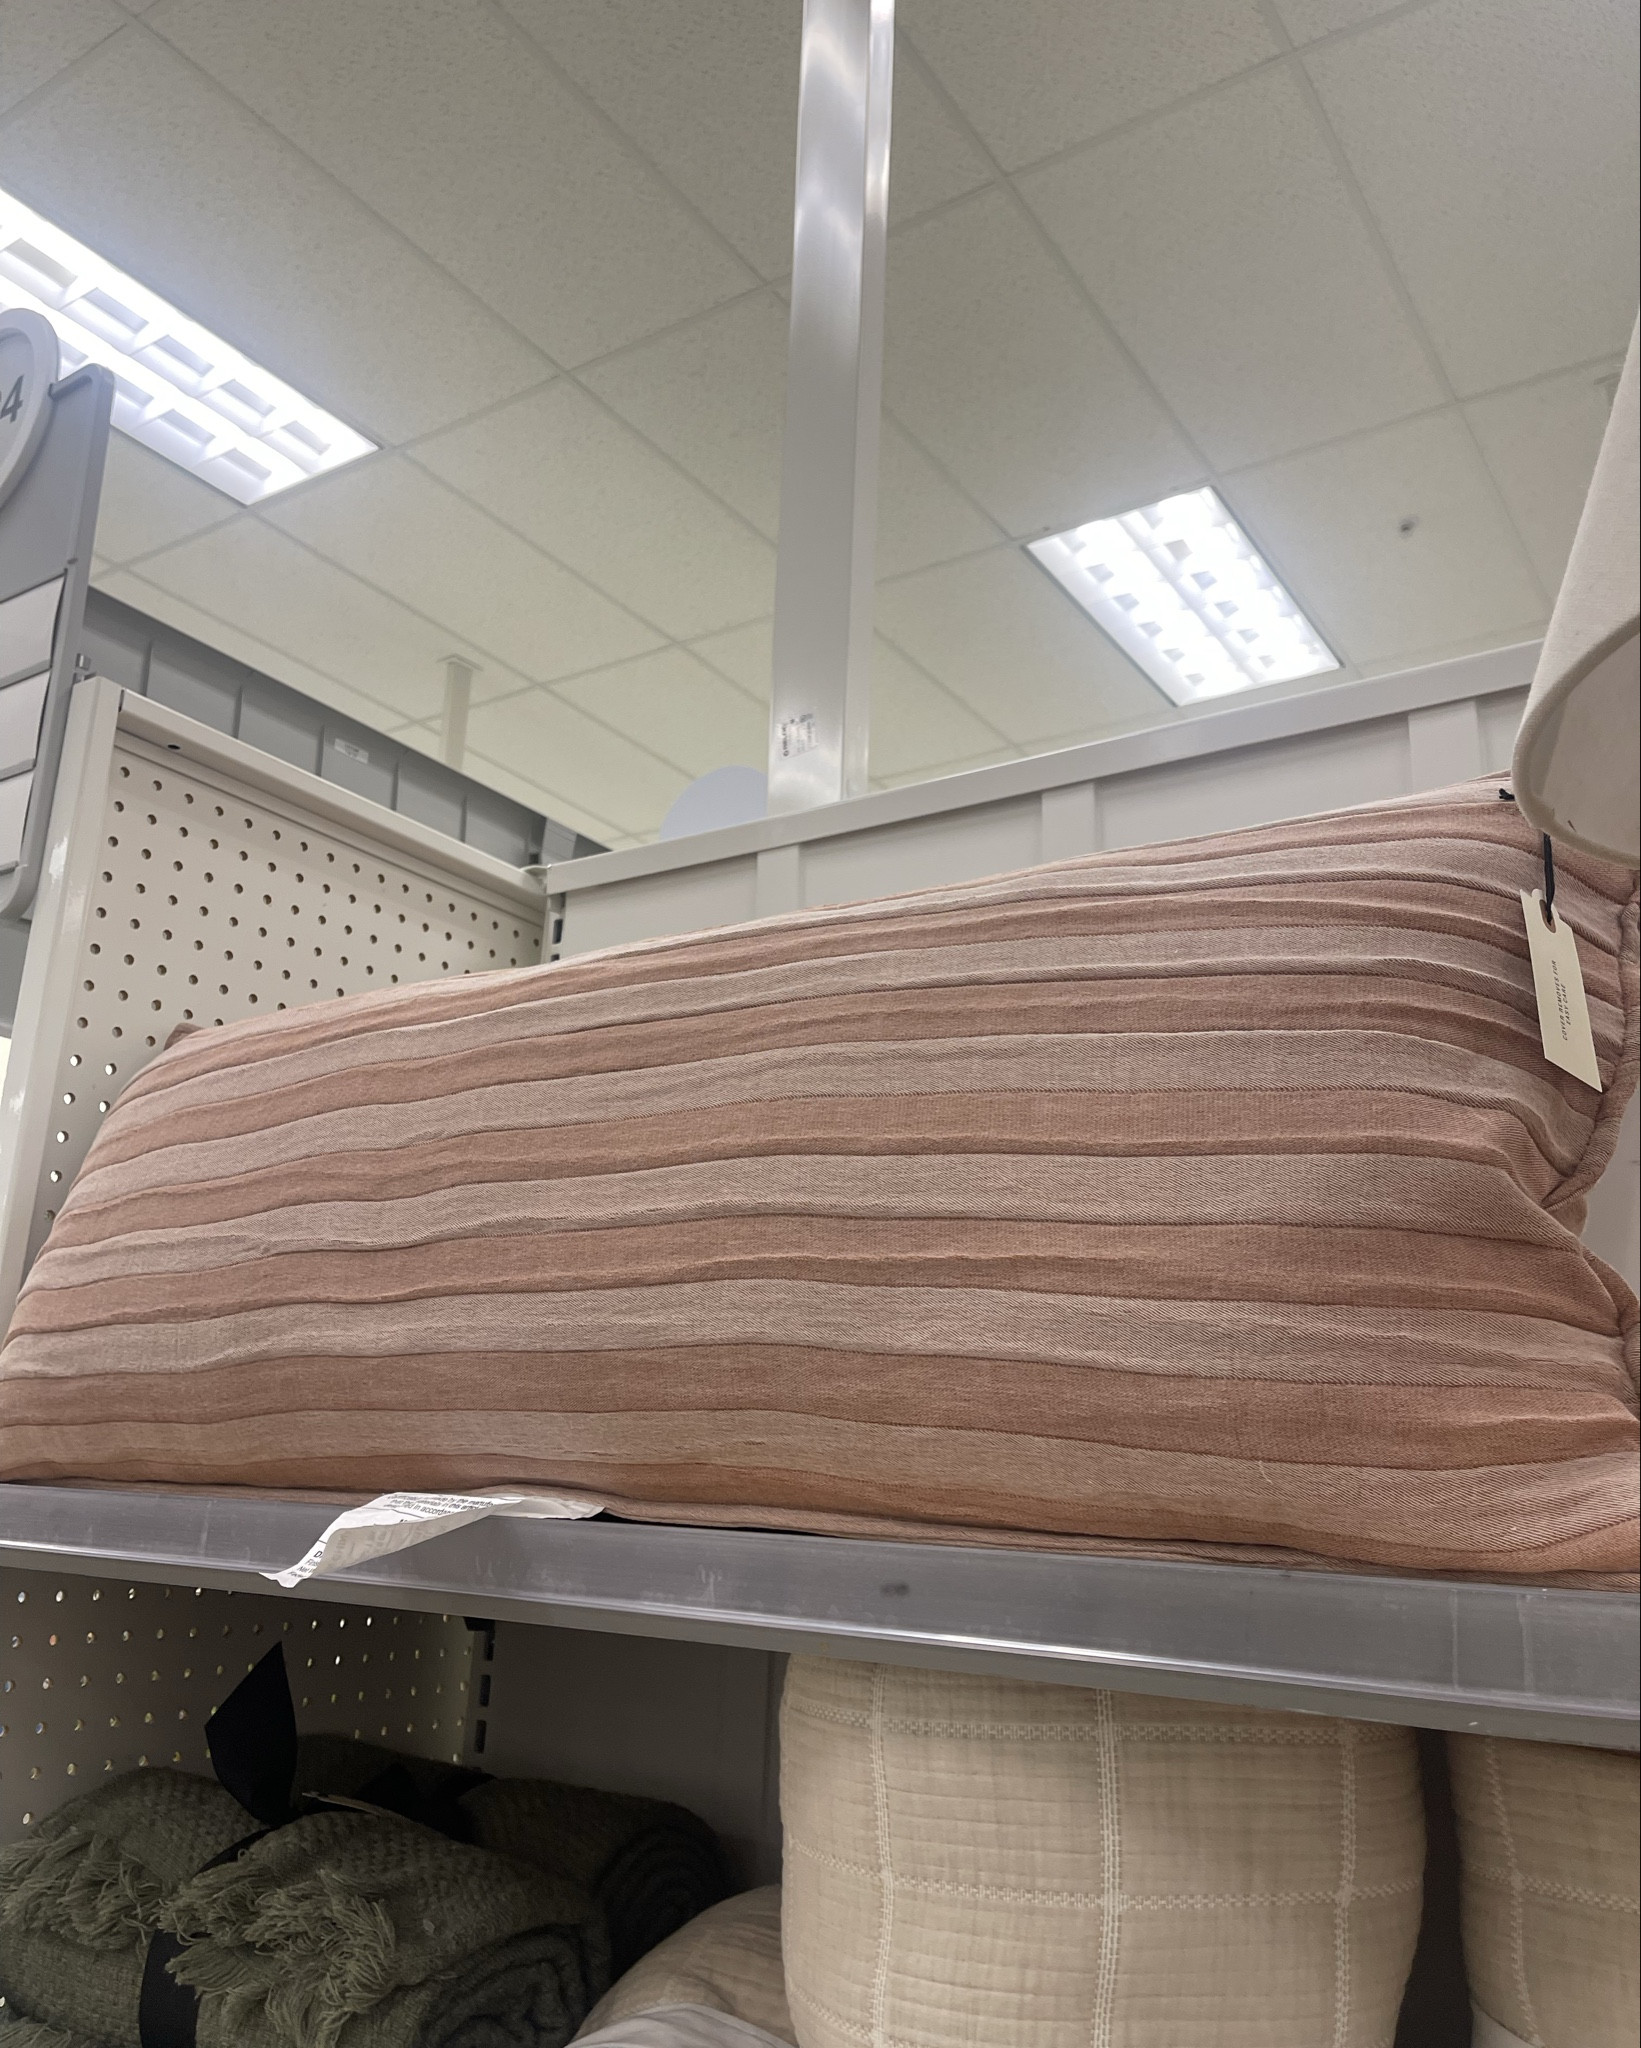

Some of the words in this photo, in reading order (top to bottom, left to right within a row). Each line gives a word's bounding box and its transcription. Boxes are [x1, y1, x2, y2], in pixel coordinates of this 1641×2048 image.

[0, 374, 24, 424] 4
[1554, 976, 1564, 1013] REMOVES
[1560, 1015, 1568, 1041] COVER
[1563, 1004, 1571, 1026] EASY
